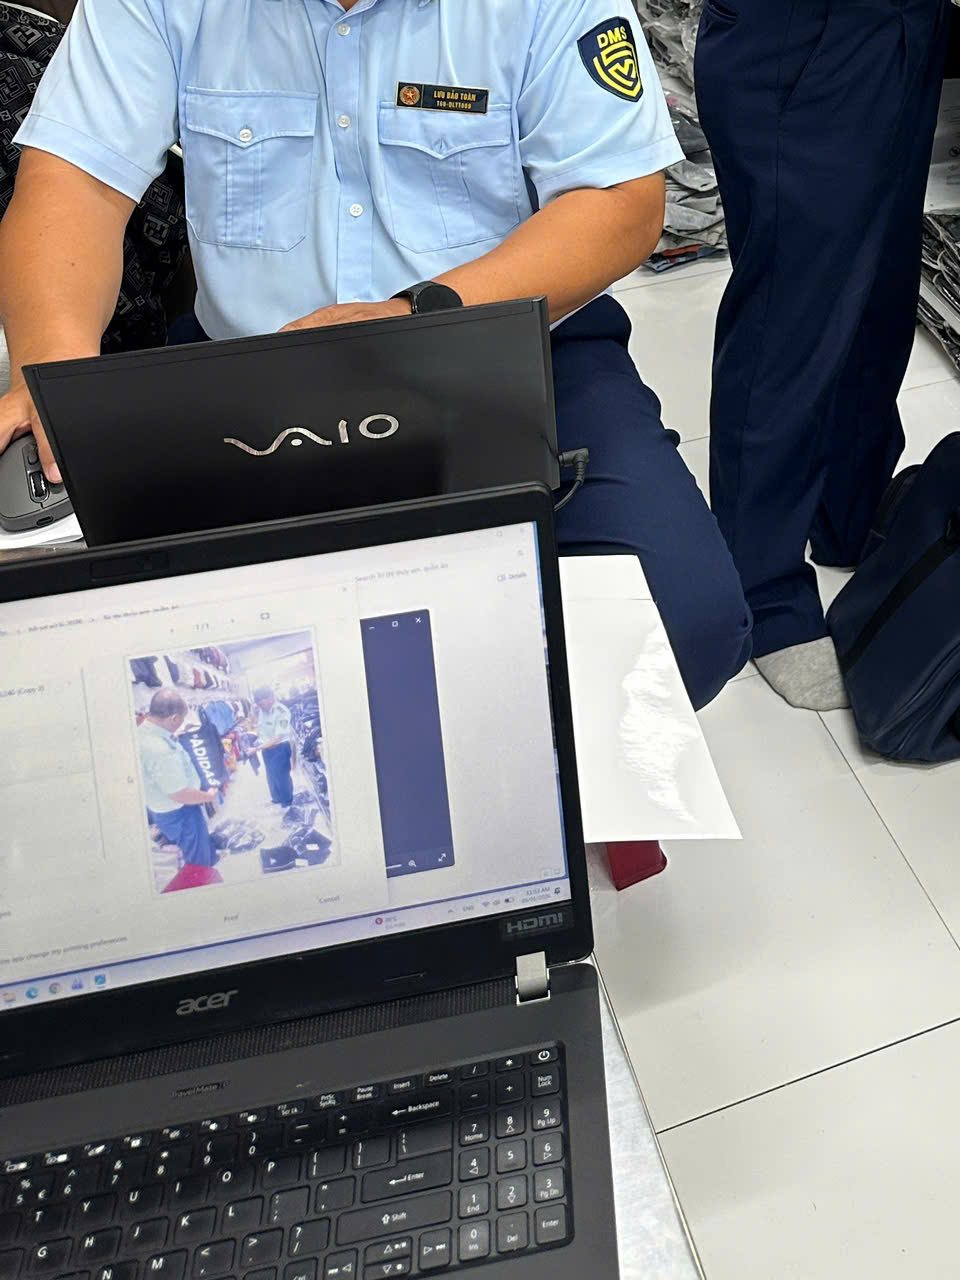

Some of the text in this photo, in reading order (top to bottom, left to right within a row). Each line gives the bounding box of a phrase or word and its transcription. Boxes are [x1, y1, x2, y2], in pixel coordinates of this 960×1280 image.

[596, 26, 627, 49] DMS
[223, 413, 400, 456] VAIO
[189, 738, 222, 787] ADIDAS
[506, 912, 563, 933] HDMI
[176, 989, 239, 1016] acer
[429, 1073, 449, 1082] Delete
[537, 1074, 553, 1082] Num
[393, 1080, 411, 1090] Insert
[537, 1080, 553, 1088] Lock
[408, 1100, 440, 1113] Backspace
[543, 1108, 550, 1118] 9
[506, 1116, 513, 1125] 8
[537, 1117, 556, 1127] Pg Up
[471, 1123, 478, 1132] 7
[544, 1142, 551, 1152] 6
[204, 1154, 210, 1166] 9
[507, 1150, 514, 1160] 5
[267, 1162, 276, 1173] P
[470, 1158, 477, 1167] 4
[407, 1171, 425, 1182] Enter
[546, 1178, 552, 1188] 3
[64, 1184, 72, 1194] 6
[540, 1188, 559, 1199] Pg Dn
[129, 1190, 138, 1202] U
[471, 1194, 476, 1203] 1
[82, 1200, 91, 1212] Y
[228, 1206, 235, 1217] L
[466, 1204, 480, 1214] End
[34, 1210, 43, 1222] T
[180, 1215, 190, 1228] K
[391, 1212, 407, 1222] Shift
[542, 1219, 560, 1228] Enter
[134, 1226, 140, 1238] J
[470, 1228, 478, 1239] 0
[84, 1236, 94, 1248] H
[506, 1234, 518, 1243] Del
[37, 1246, 48, 1258] G
[152, 1258, 164, 1270] M
[102, 1270, 112, 1280] N
